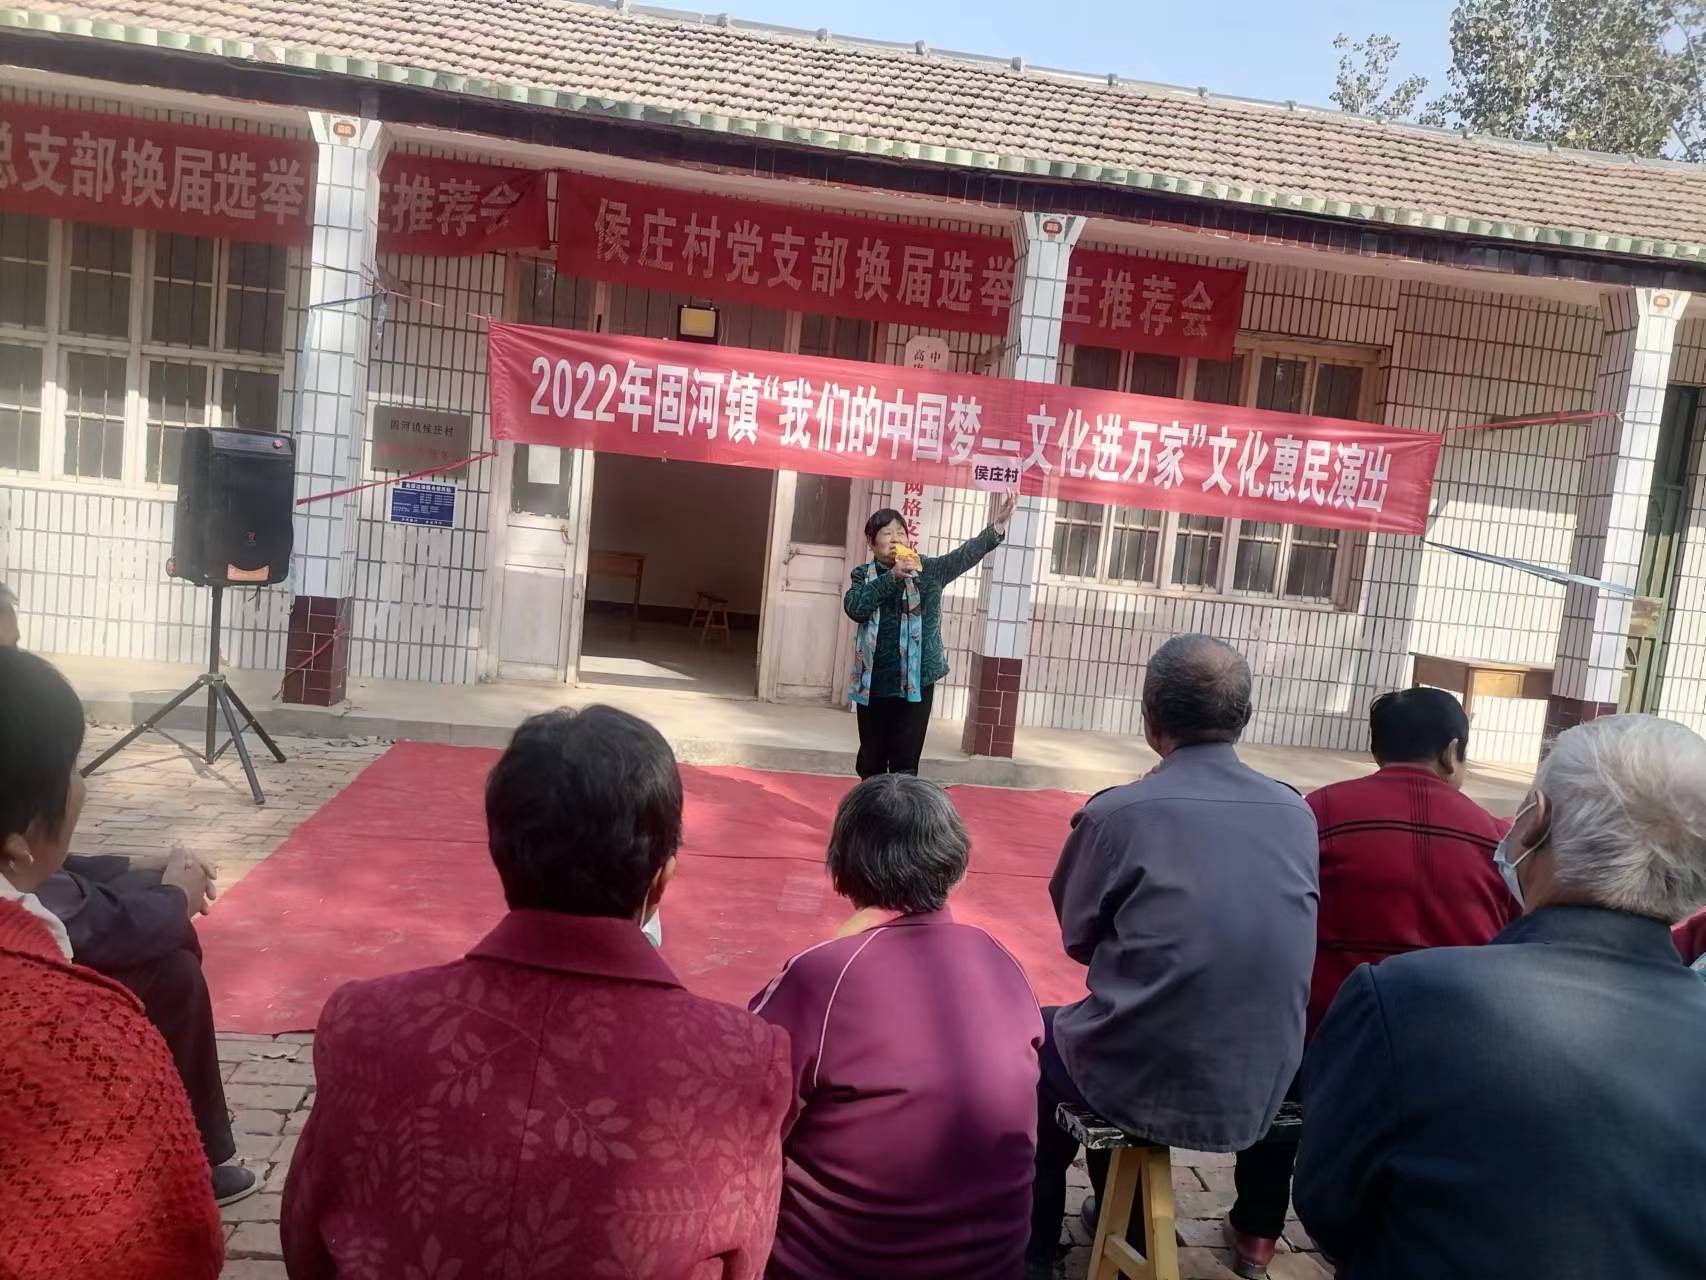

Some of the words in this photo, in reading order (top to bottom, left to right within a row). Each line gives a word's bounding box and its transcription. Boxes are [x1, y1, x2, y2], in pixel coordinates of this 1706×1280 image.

[594, 198, 1213, 337] 侯庄村党支部换届选举主推荐会
[974, 465, 1019, 482] 侯庄村
